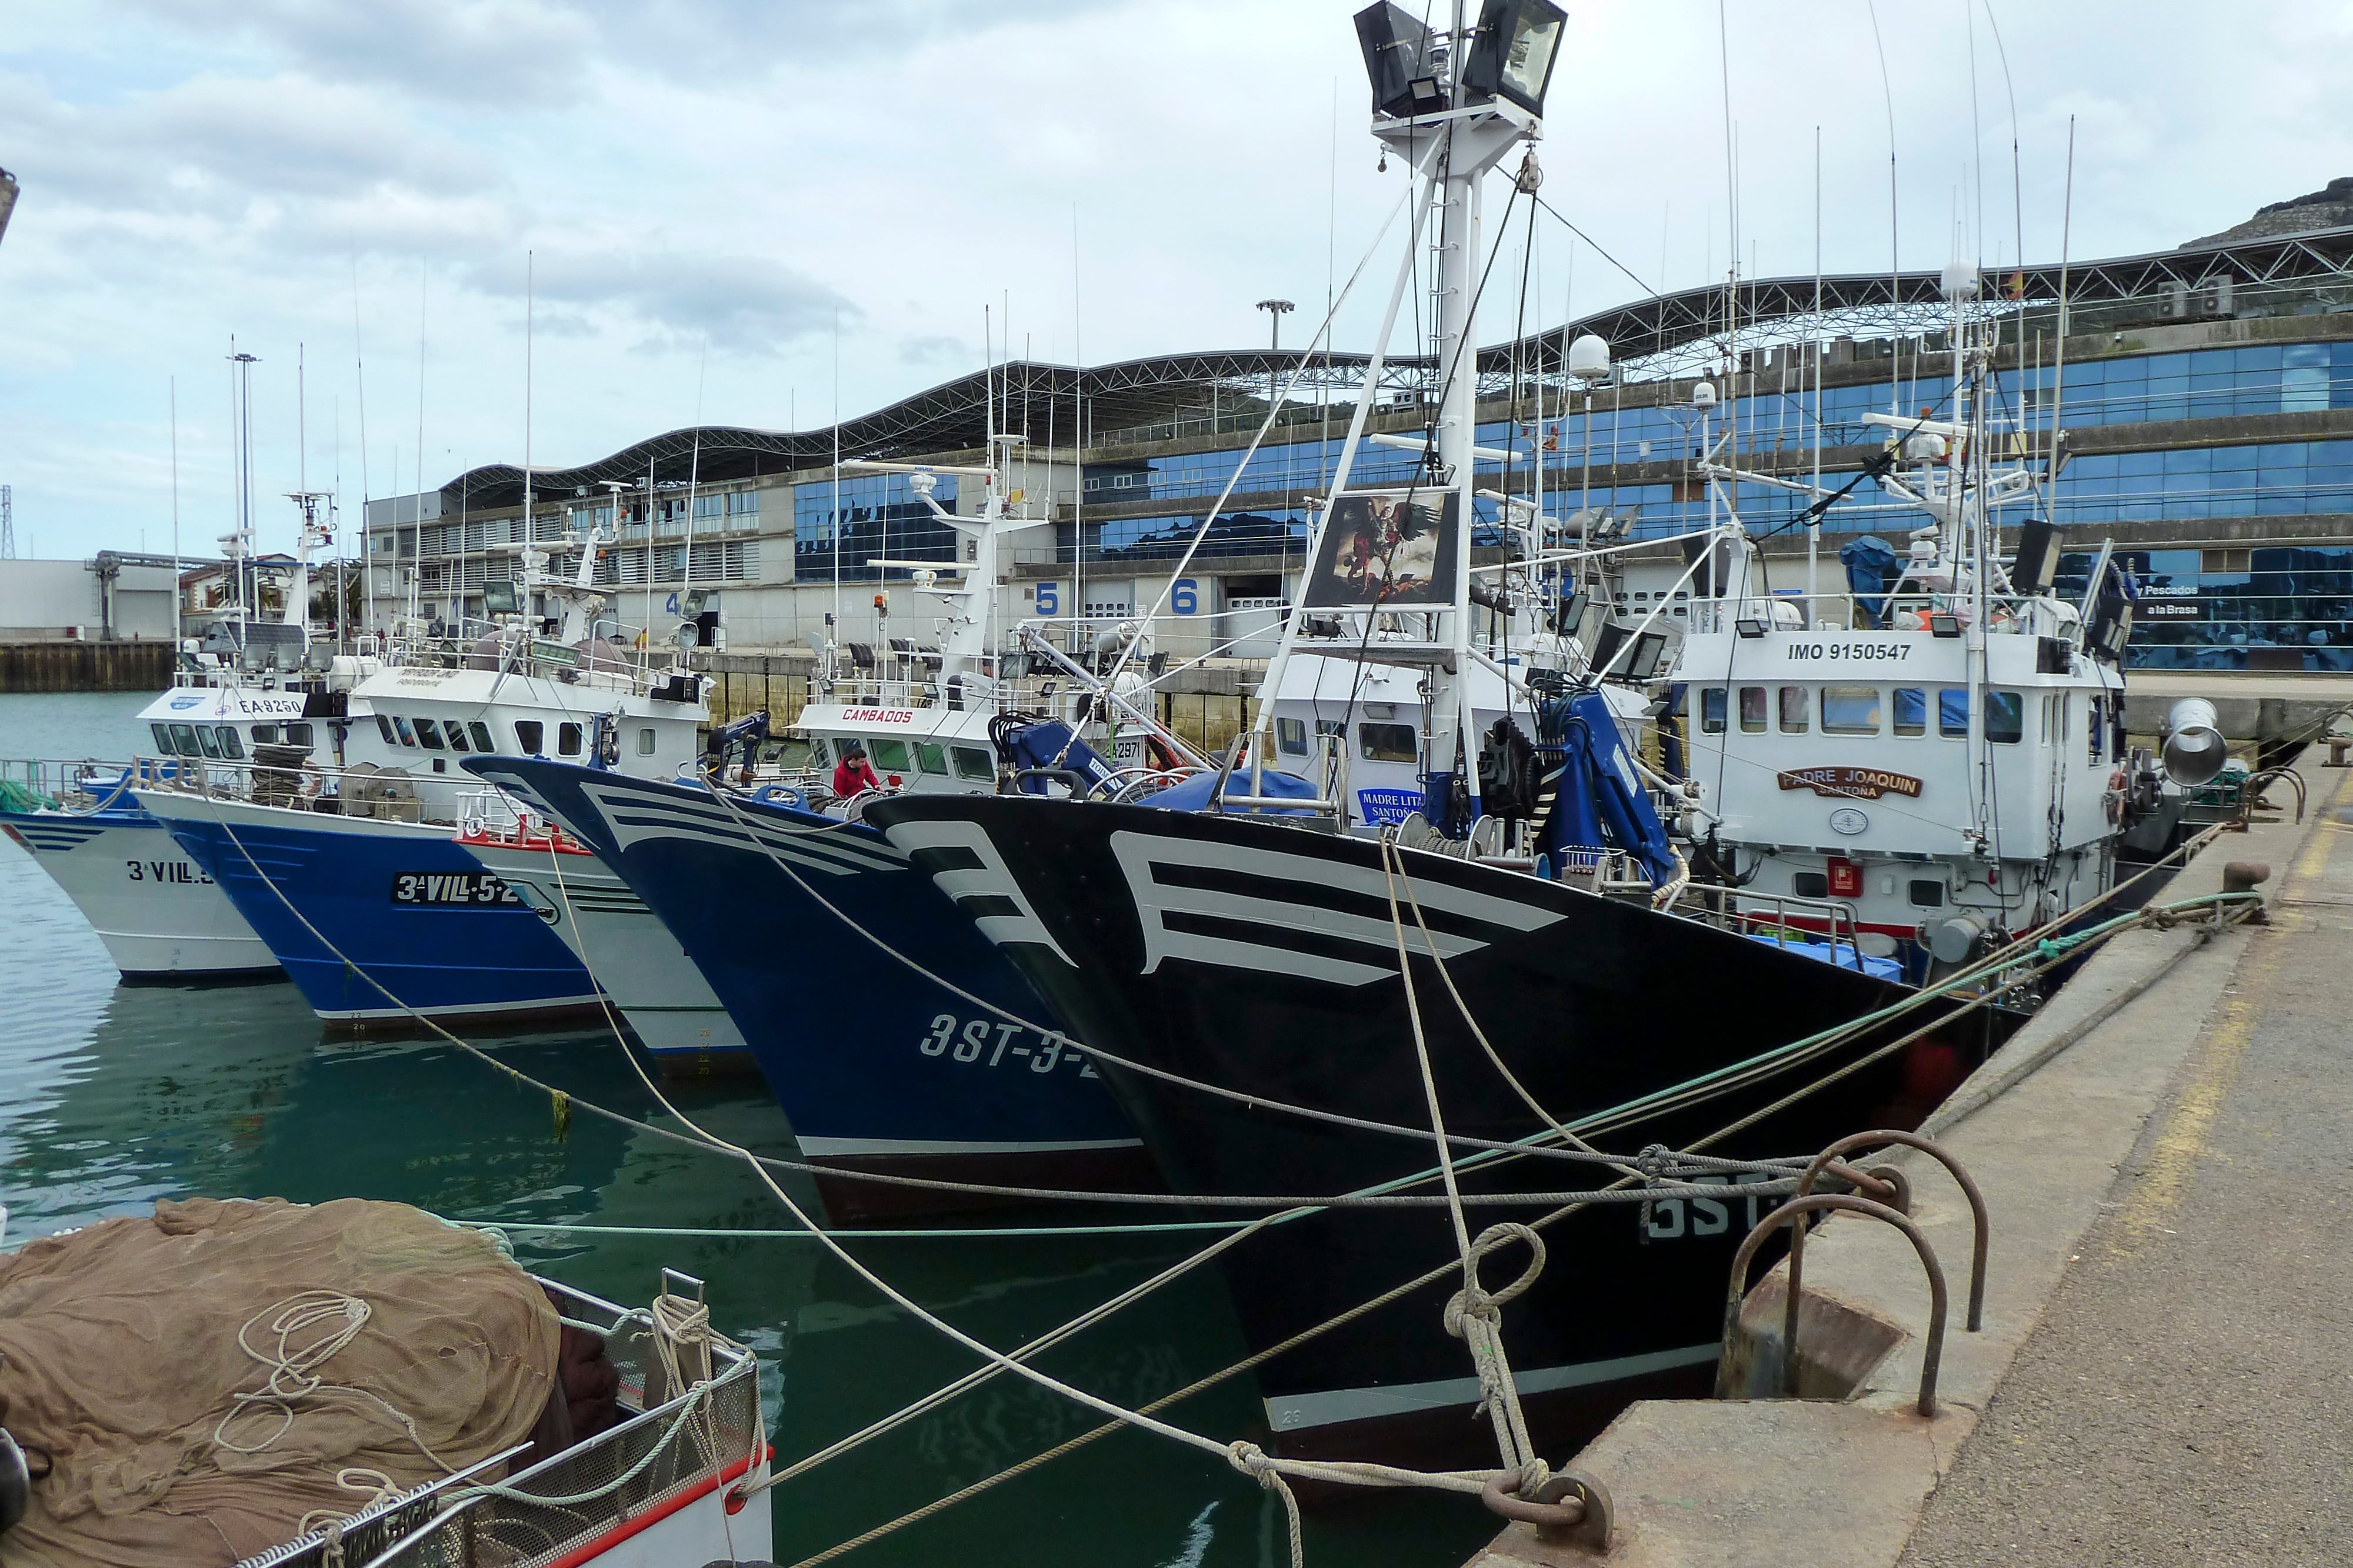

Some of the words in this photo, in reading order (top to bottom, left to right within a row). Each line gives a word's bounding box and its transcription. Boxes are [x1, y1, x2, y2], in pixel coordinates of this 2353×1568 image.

[1171, 579, 1197, 615] 6
[2145, 586, 2198, 595] Pescados
[666, 593, 678, 615] 4
[1036, 583, 1058, 615] 5
[2167, 605, 2198, 614] Brasa
[1788, 644, 1824, 660] IMO
[1829, 643, 1911, 660] 9150547
[239, 700, 302, 713] EA-9250
[842, 709, 913, 723] CAMBADOS
[1783, 769, 1836, 787] PADRE
[1845, 770, 1917, 793] JOAQUIN
[1819, 785, 1877, 797] SANTOÑA
[1364, 793, 1399, 805] MADRE
[1401, 796, 1422, 806] LITA
[1372, 806, 1414, 818] SANTOÑ
